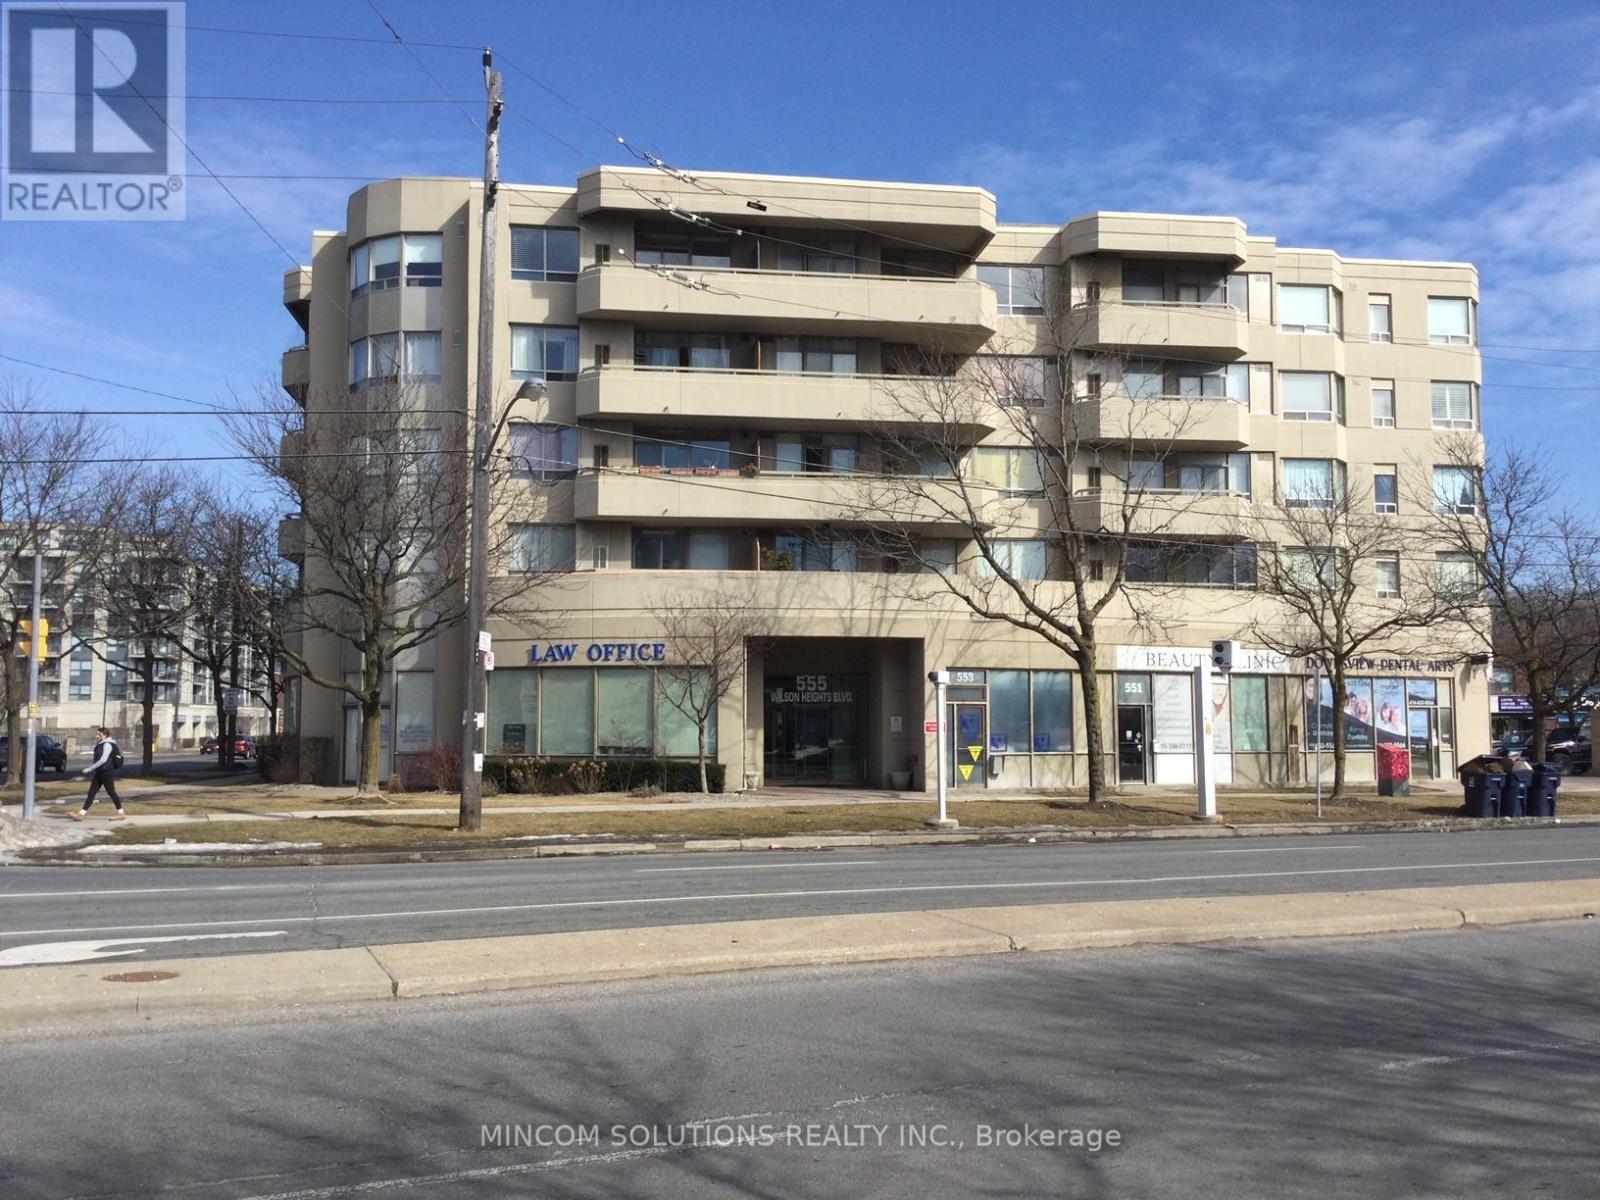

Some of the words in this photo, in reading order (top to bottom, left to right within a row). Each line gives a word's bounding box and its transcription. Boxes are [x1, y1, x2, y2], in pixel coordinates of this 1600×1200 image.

[530, 643, 579, 663] LAW
[586, 643, 666, 662] OFFICE
[1145, 651, 1213, 667] BEAUT
[1305, 656, 1375, 671] DOWSVIEW
[1379, 658, 1422, 672] DENTAL
[1427, 660, 1455, 673] ARTS
[796, 675, 828, 692] 555
[956, 671, 975, 682] 553
[1124, 683, 1143, 694] 551
[770, 691, 800, 703] WLSON
[801, 691, 833, 703] HEIGHTS
